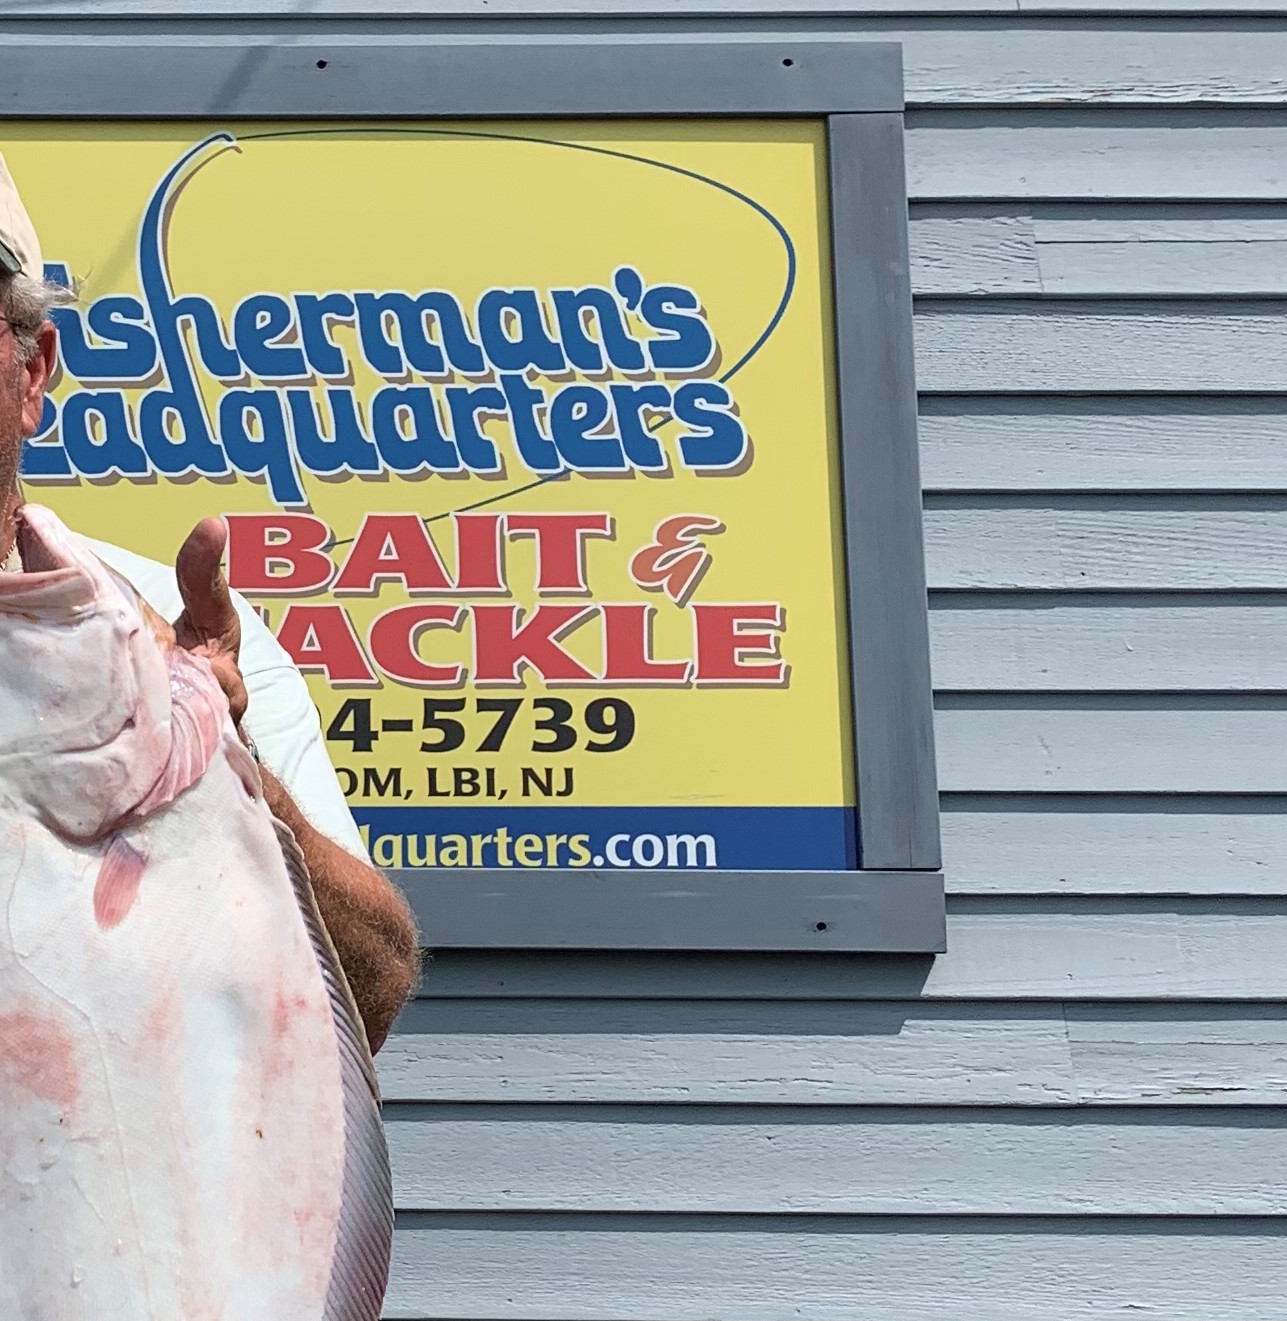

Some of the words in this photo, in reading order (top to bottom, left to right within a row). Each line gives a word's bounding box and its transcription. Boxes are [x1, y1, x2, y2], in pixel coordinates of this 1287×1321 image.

[42, 265, 716, 381] isherman's
[20, 374, 751, 504] eadquarters
[223, 512, 614, 594] BAIT
[629, 513, 726, 604] &
[273, 602, 789, 688] ACKLE
[316, 697, 637, 753] 4-5739
[334, 767, 413, 801] OM,
[426, 767, 508, 801] LBI,
[520, 767, 575, 798] NJ
